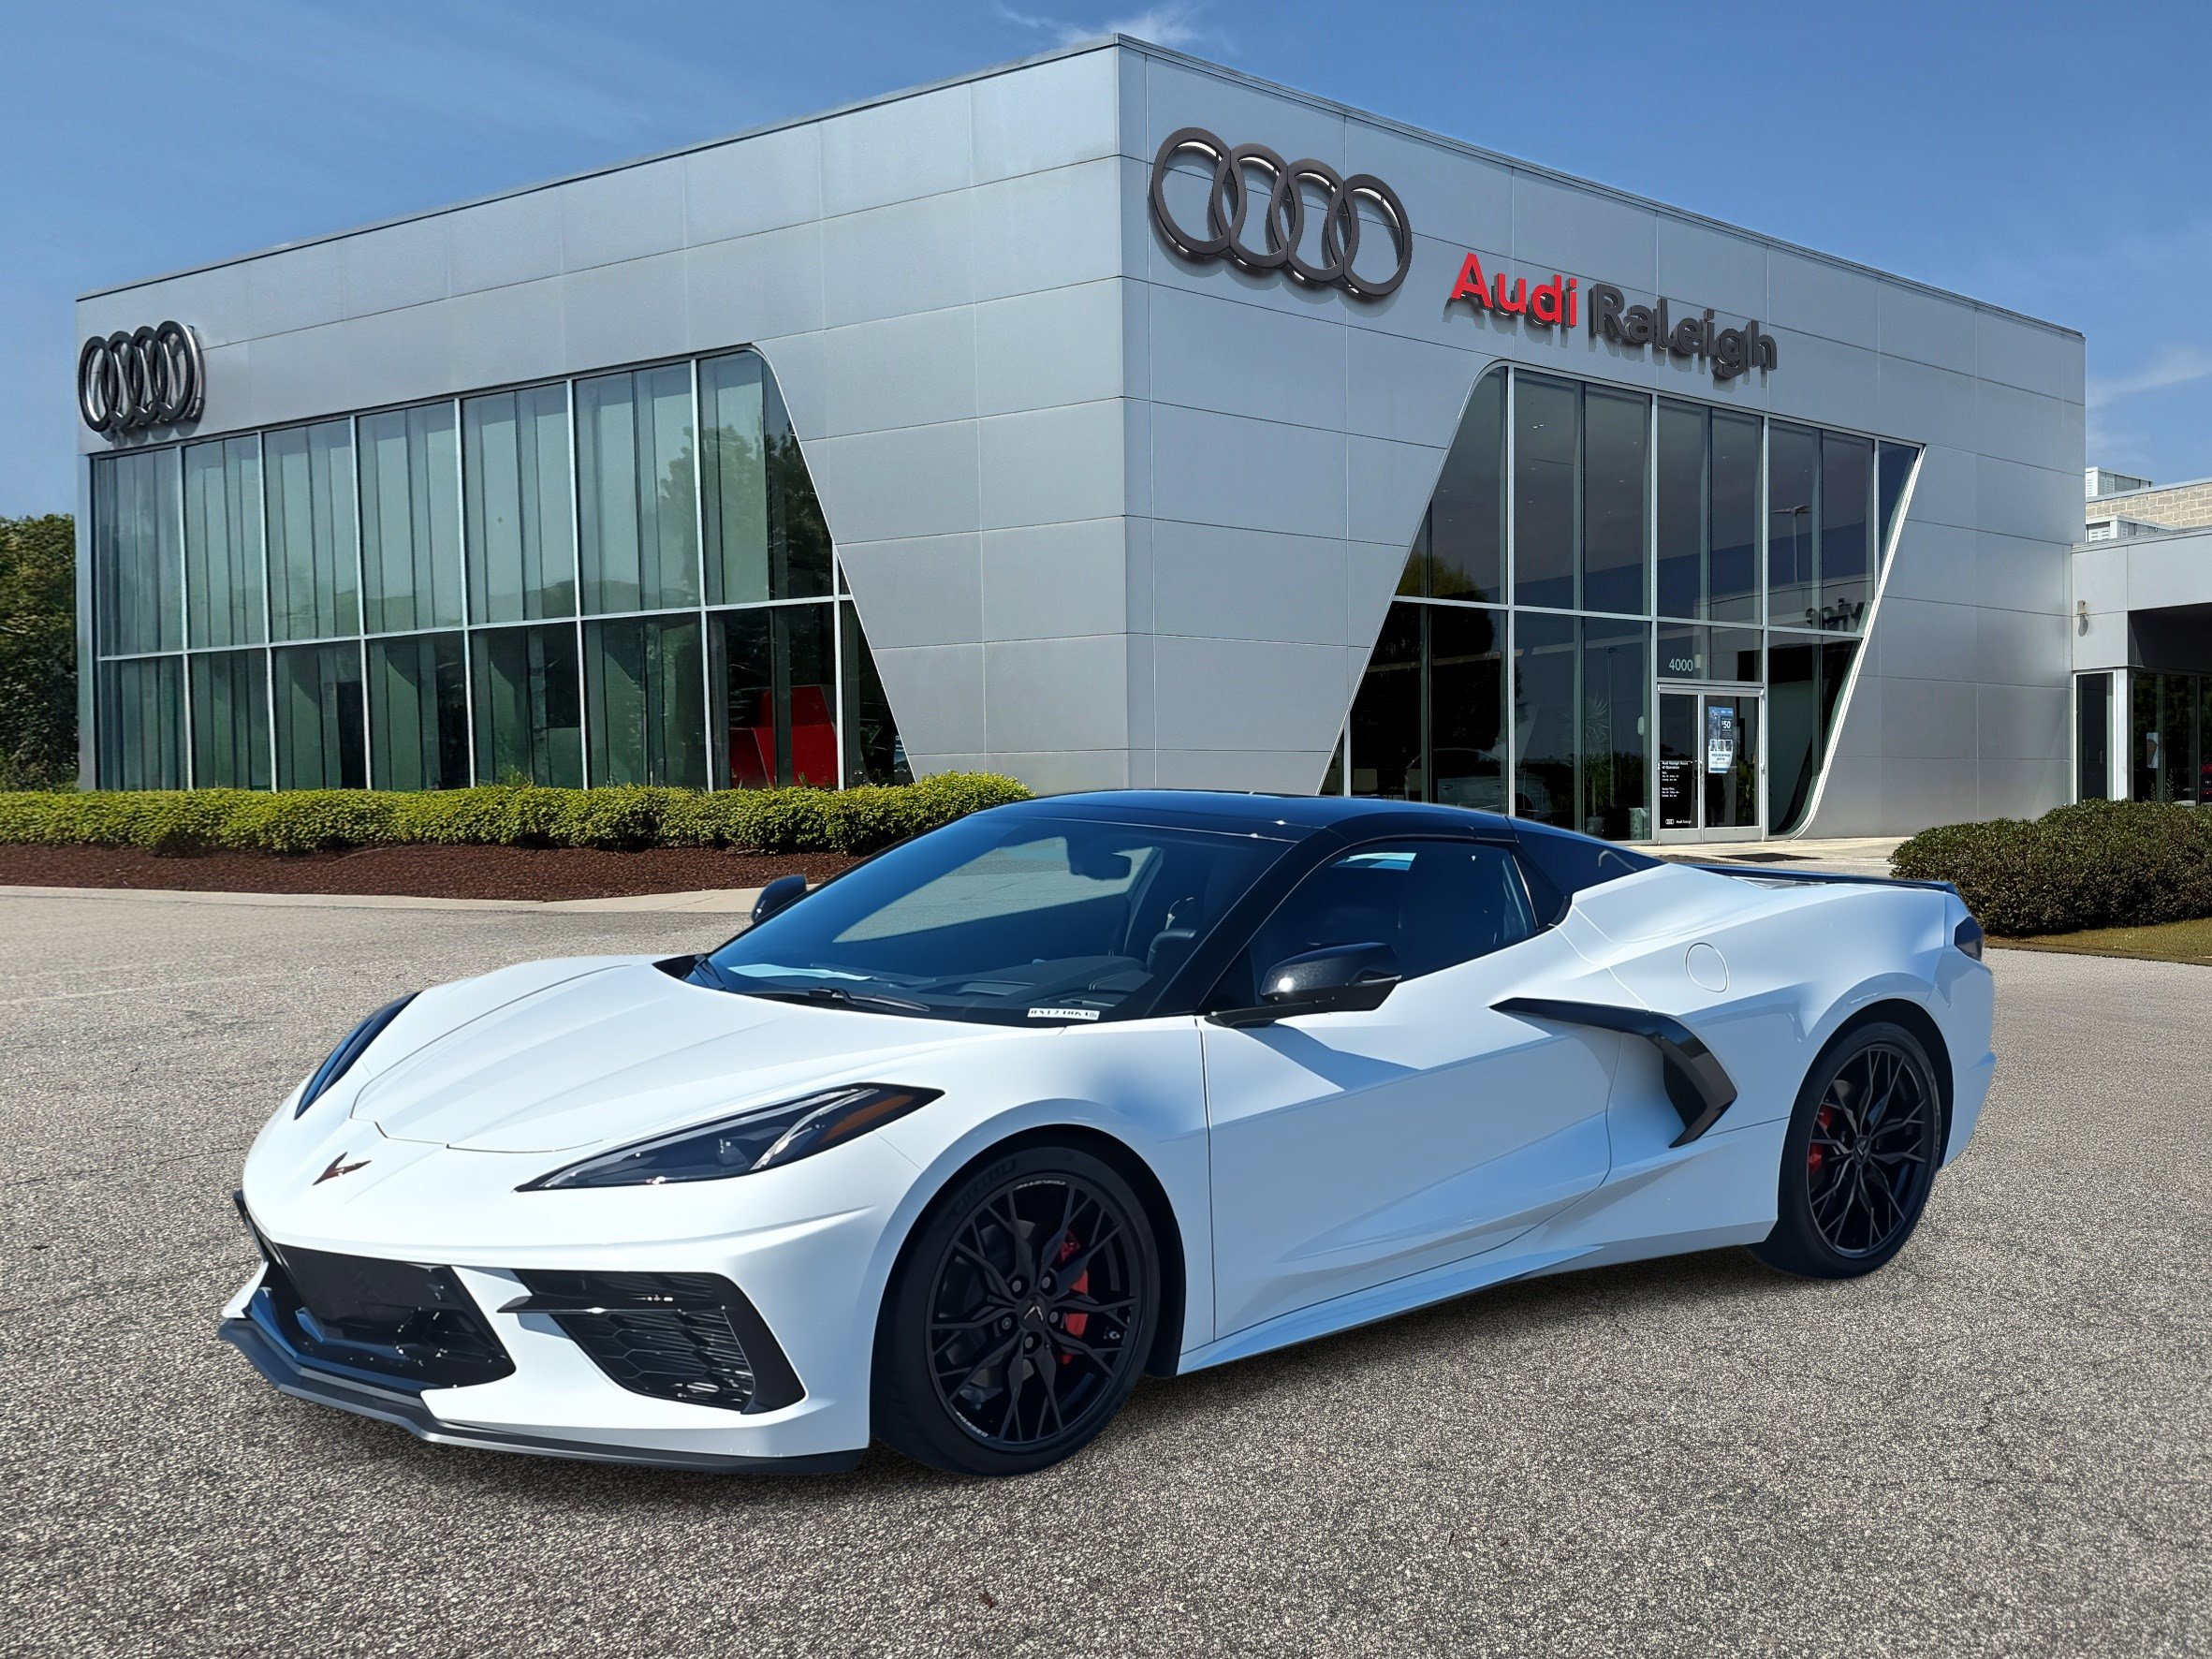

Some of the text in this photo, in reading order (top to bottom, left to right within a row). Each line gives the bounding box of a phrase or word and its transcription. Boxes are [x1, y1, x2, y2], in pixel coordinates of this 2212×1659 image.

[1450, 252, 1778, 379] Audi Raleigh
[1668, 658, 1693, 672] 4000
